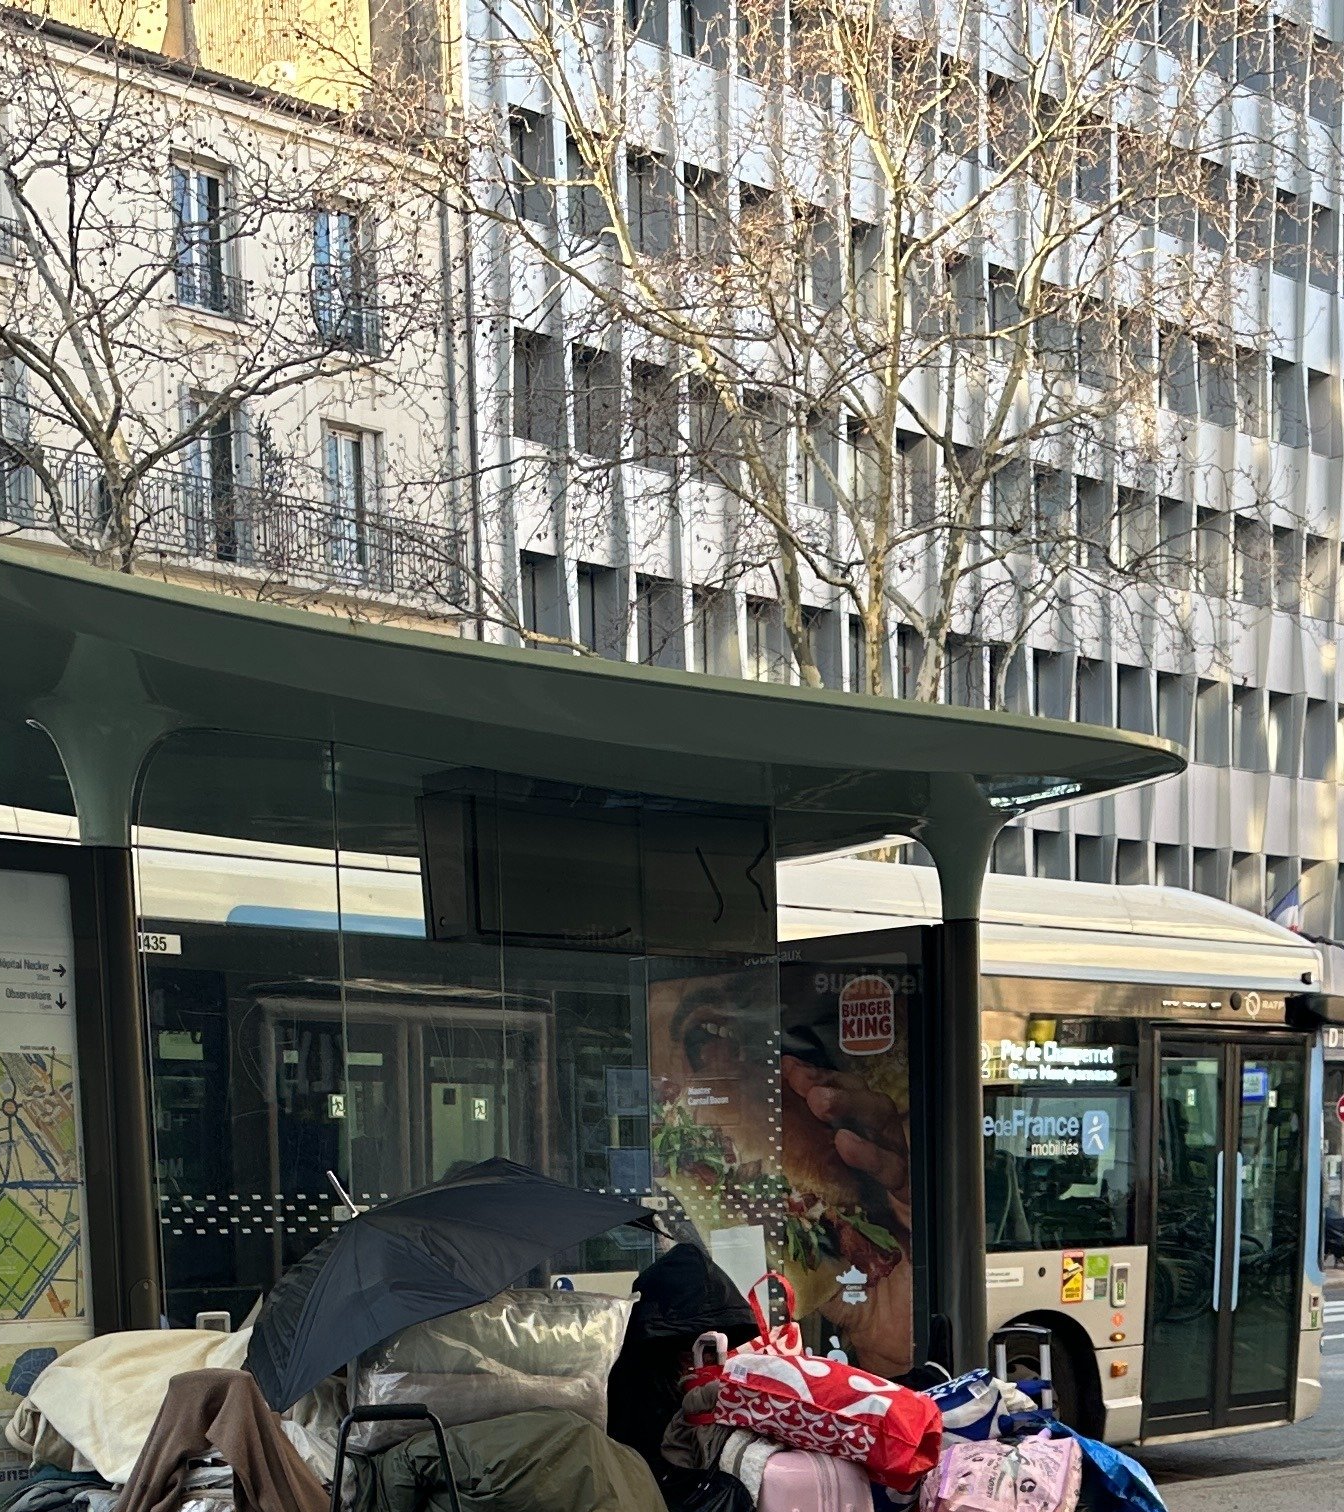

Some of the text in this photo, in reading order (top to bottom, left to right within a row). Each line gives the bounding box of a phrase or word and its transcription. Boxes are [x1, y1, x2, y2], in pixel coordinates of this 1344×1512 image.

[138, 935, 167, 952] 1435
[841, 999, 891, 1018] BURGER
[842, 1016, 892, 1039] KING
[1026, 1040, 1042, 1062] de
[1031, 1139, 1079, 1156] mobilités
